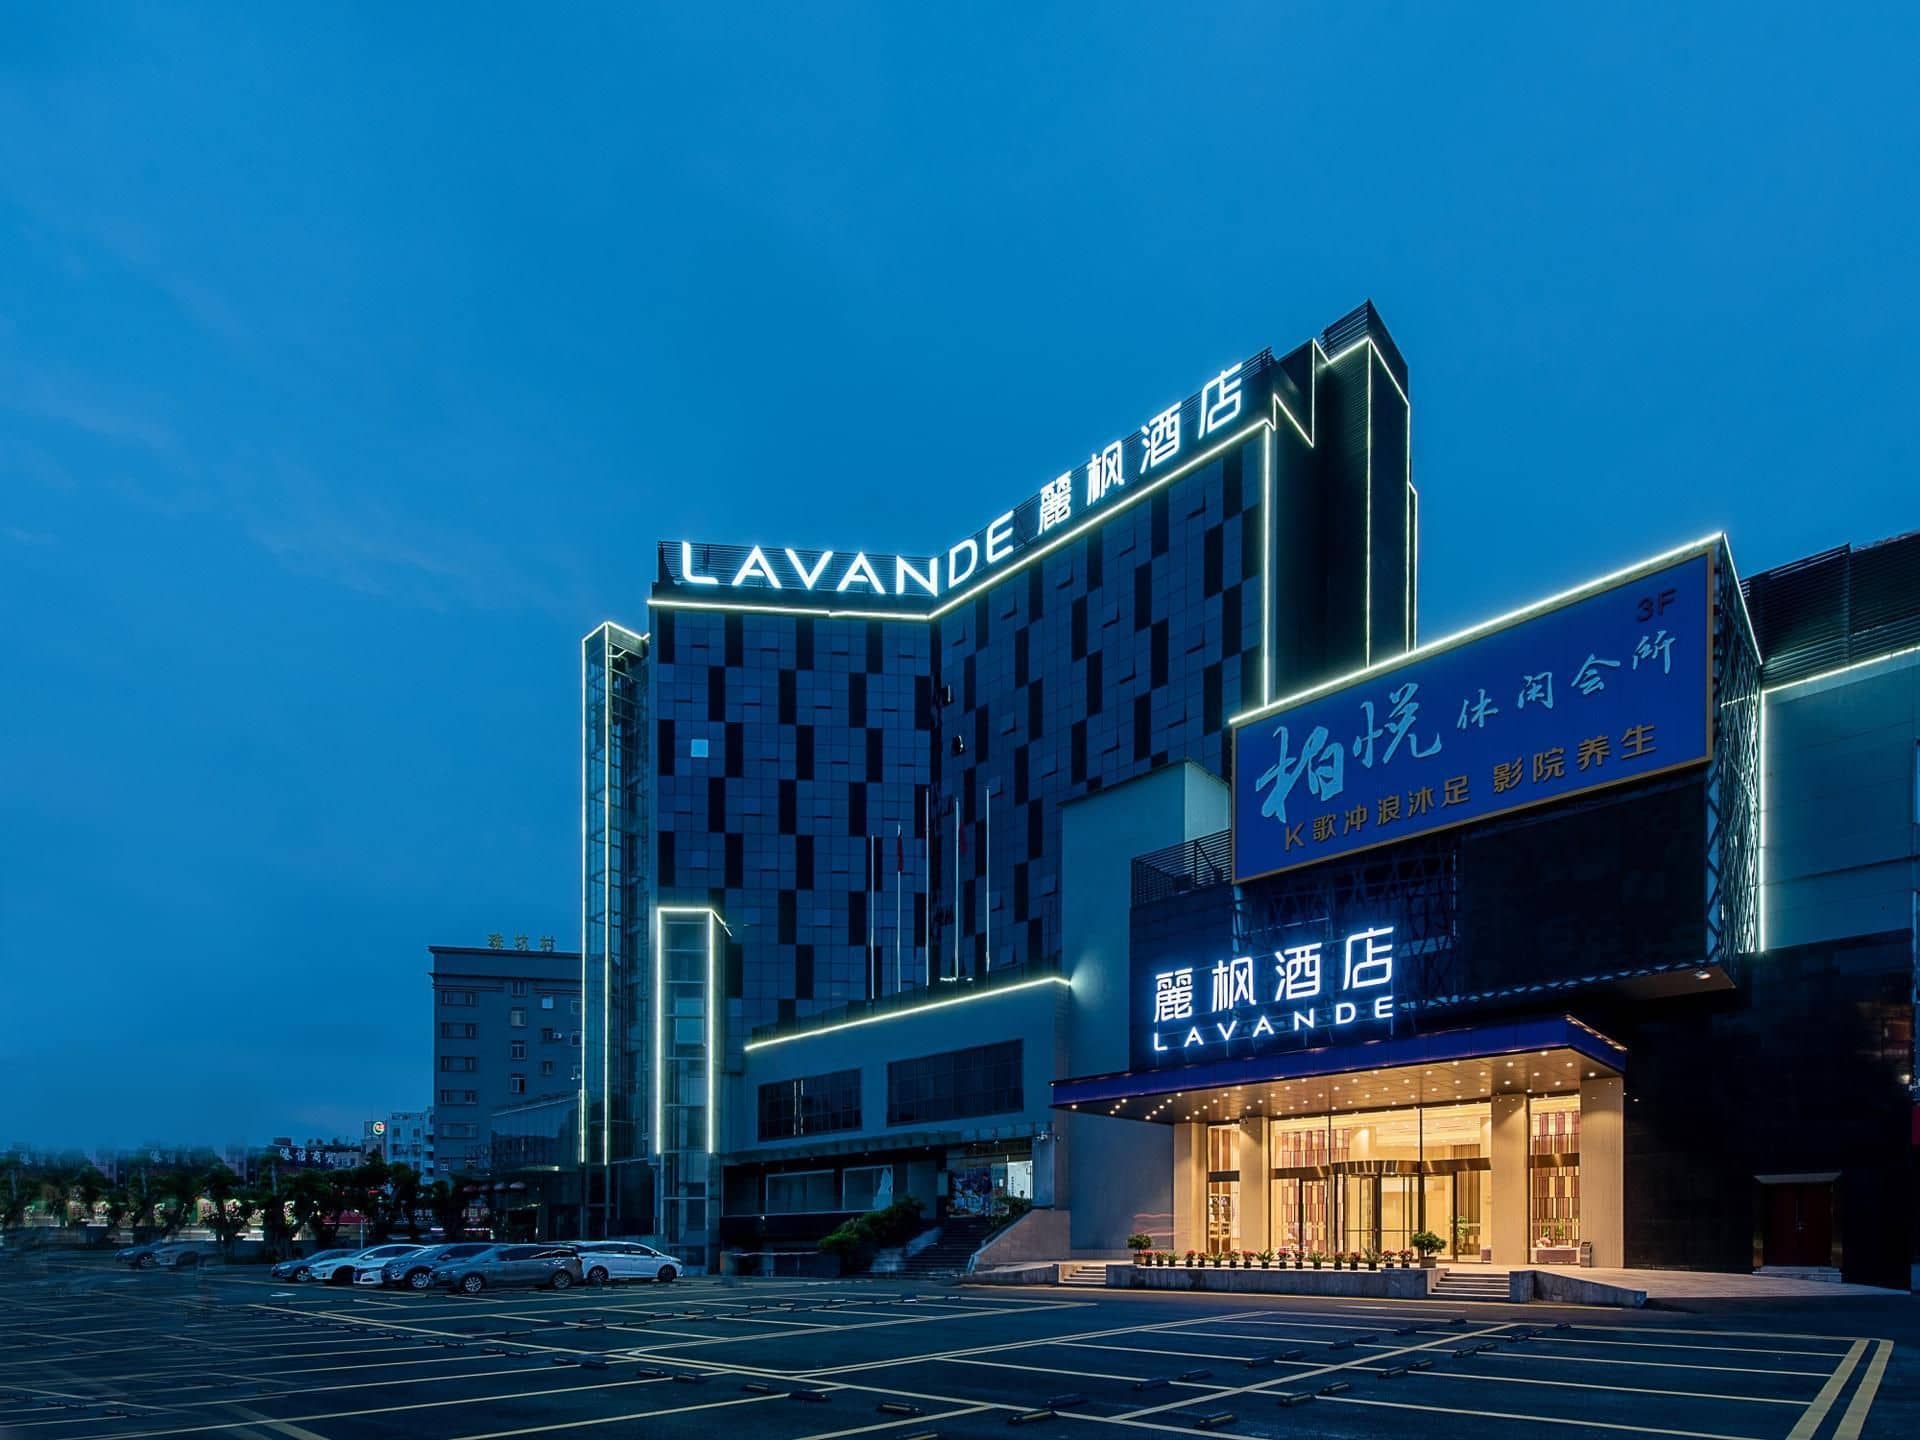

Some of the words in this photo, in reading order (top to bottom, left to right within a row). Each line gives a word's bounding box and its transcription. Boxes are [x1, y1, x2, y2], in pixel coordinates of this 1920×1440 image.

[681, 510, 1014, 598] LAVANDE
[1637, 588, 1677, 622] 3F
[1256, 683, 1441, 823] 柏悦
[1457, 630, 1676, 730] 休闲会所
[1284, 775, 1470, 850] K歌冲浪沐足
[1493, 725, 1656, 793] 影院养生
[1153, 996, 1393, 1051] LAVANDE
